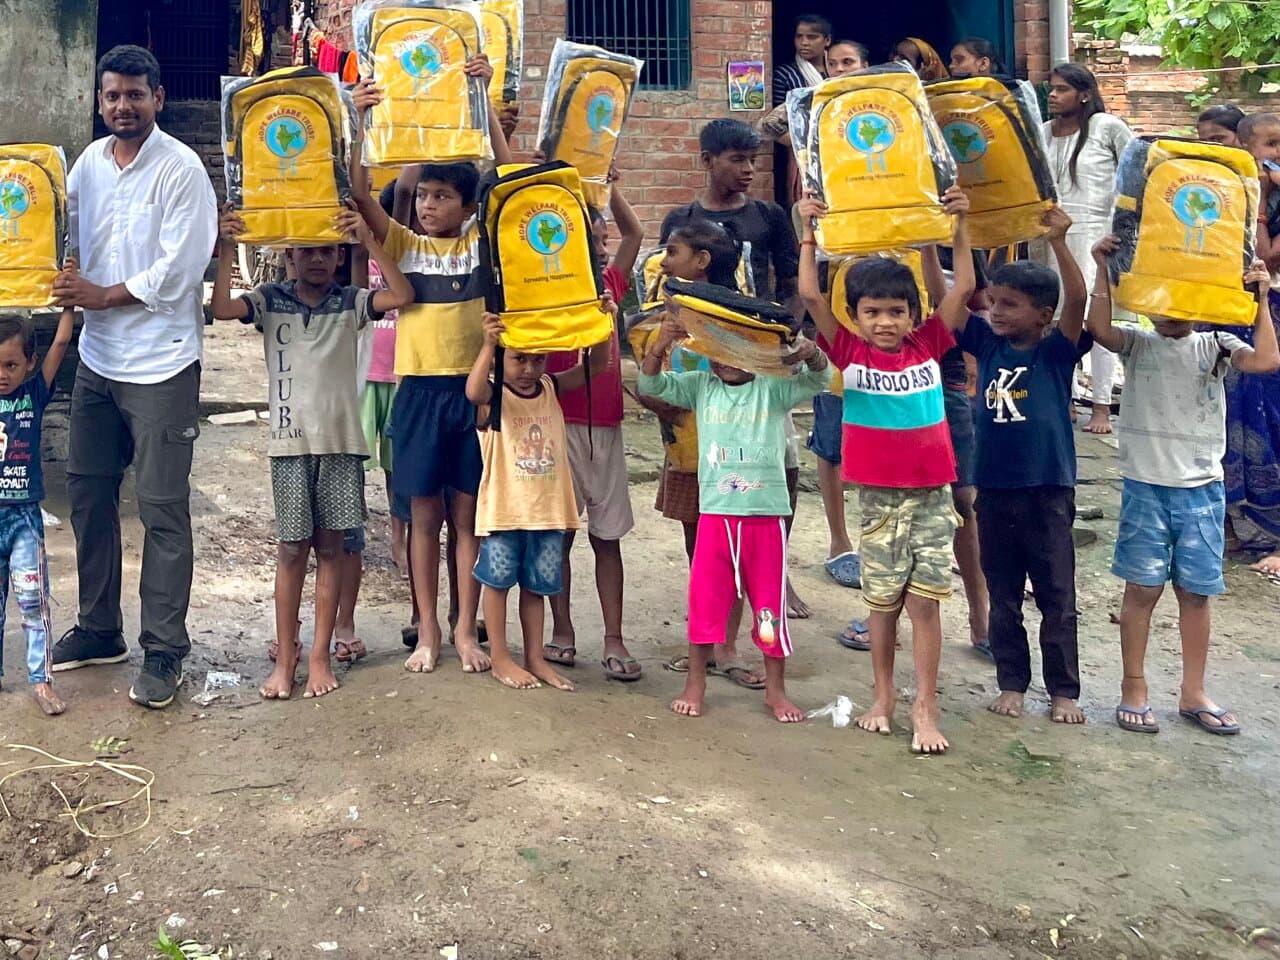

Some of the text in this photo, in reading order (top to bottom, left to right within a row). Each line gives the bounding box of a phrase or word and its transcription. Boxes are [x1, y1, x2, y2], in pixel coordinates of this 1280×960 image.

[257, 107, 316, 142] HOPE WELFARE TRUST
[847, 103, 886, 116] WELFARE
[518, 202, 575, 241] HOPE WELFARE TRUST
[276, 323, 294, 429] CLUB
[3, 466, 28, 477] SKATE
